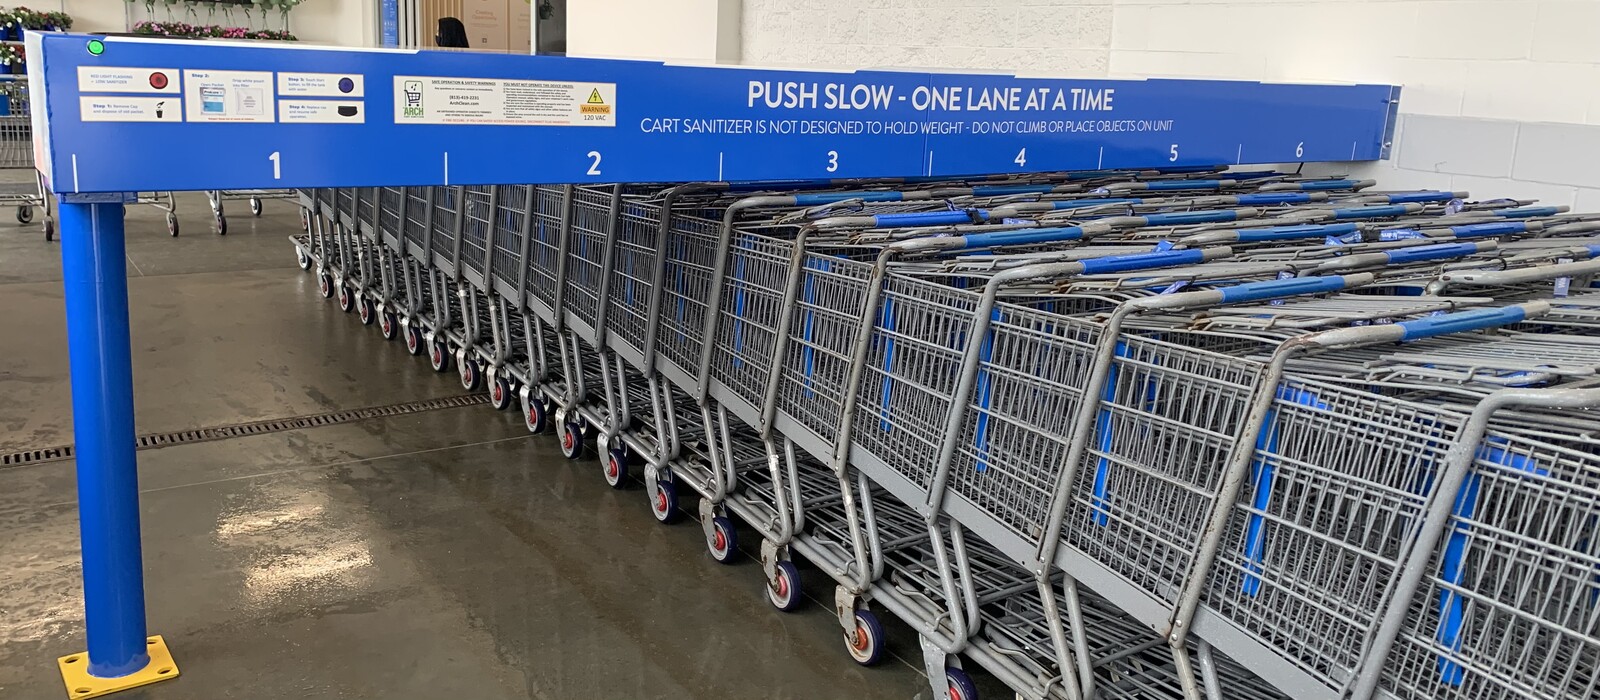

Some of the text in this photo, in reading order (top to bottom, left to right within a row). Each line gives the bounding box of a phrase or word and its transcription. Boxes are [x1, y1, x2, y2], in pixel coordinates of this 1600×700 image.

[748, 81, 817, 109] PUSH
[824, 83, 894, 110] SLOW
[911, 85, 963, 111] ONE
[966, 87, 1022, 111] LANE
[1024, 87, 1051, 111] AT
[1052, 88, 1067, 111] A
[1070, 88, 1115, 111] TIME
[640, 117, 681, 133] CART
[683, 118, 753, 134] SANITIZER
[755, 119, 767, 134] IS
[769, 120, 798, 134] NOT
[800, 120, 864, 134] DESIGNED
[865, 121, 882, 135] TO
[884, 121, 918, 134] HOLD
[920, 121, 964, 134] WEIGHT
[972, 121, 990, 134] DO
[991, 121, 1015, 134] NOT
[1016, 120, 1047, 133] CLIMB
[1048, 120, 1064, 133] OR
[1065, 120, 1096, 133] PLACE
[1096, 120, 1136, 132] OBJECTS
[1137, 120, 1152, 132] ON
[1153, 120, 1173, 132] UNIT
[1014, 147, 1026, 167] 4
[1169, 144, 1179, 162] 5
[1295, 142, 1304, 158] 6
[268, 151, 281, 180] 1
[586, 150, 602, 176] 2
[826, 150, 838, 172] 3
